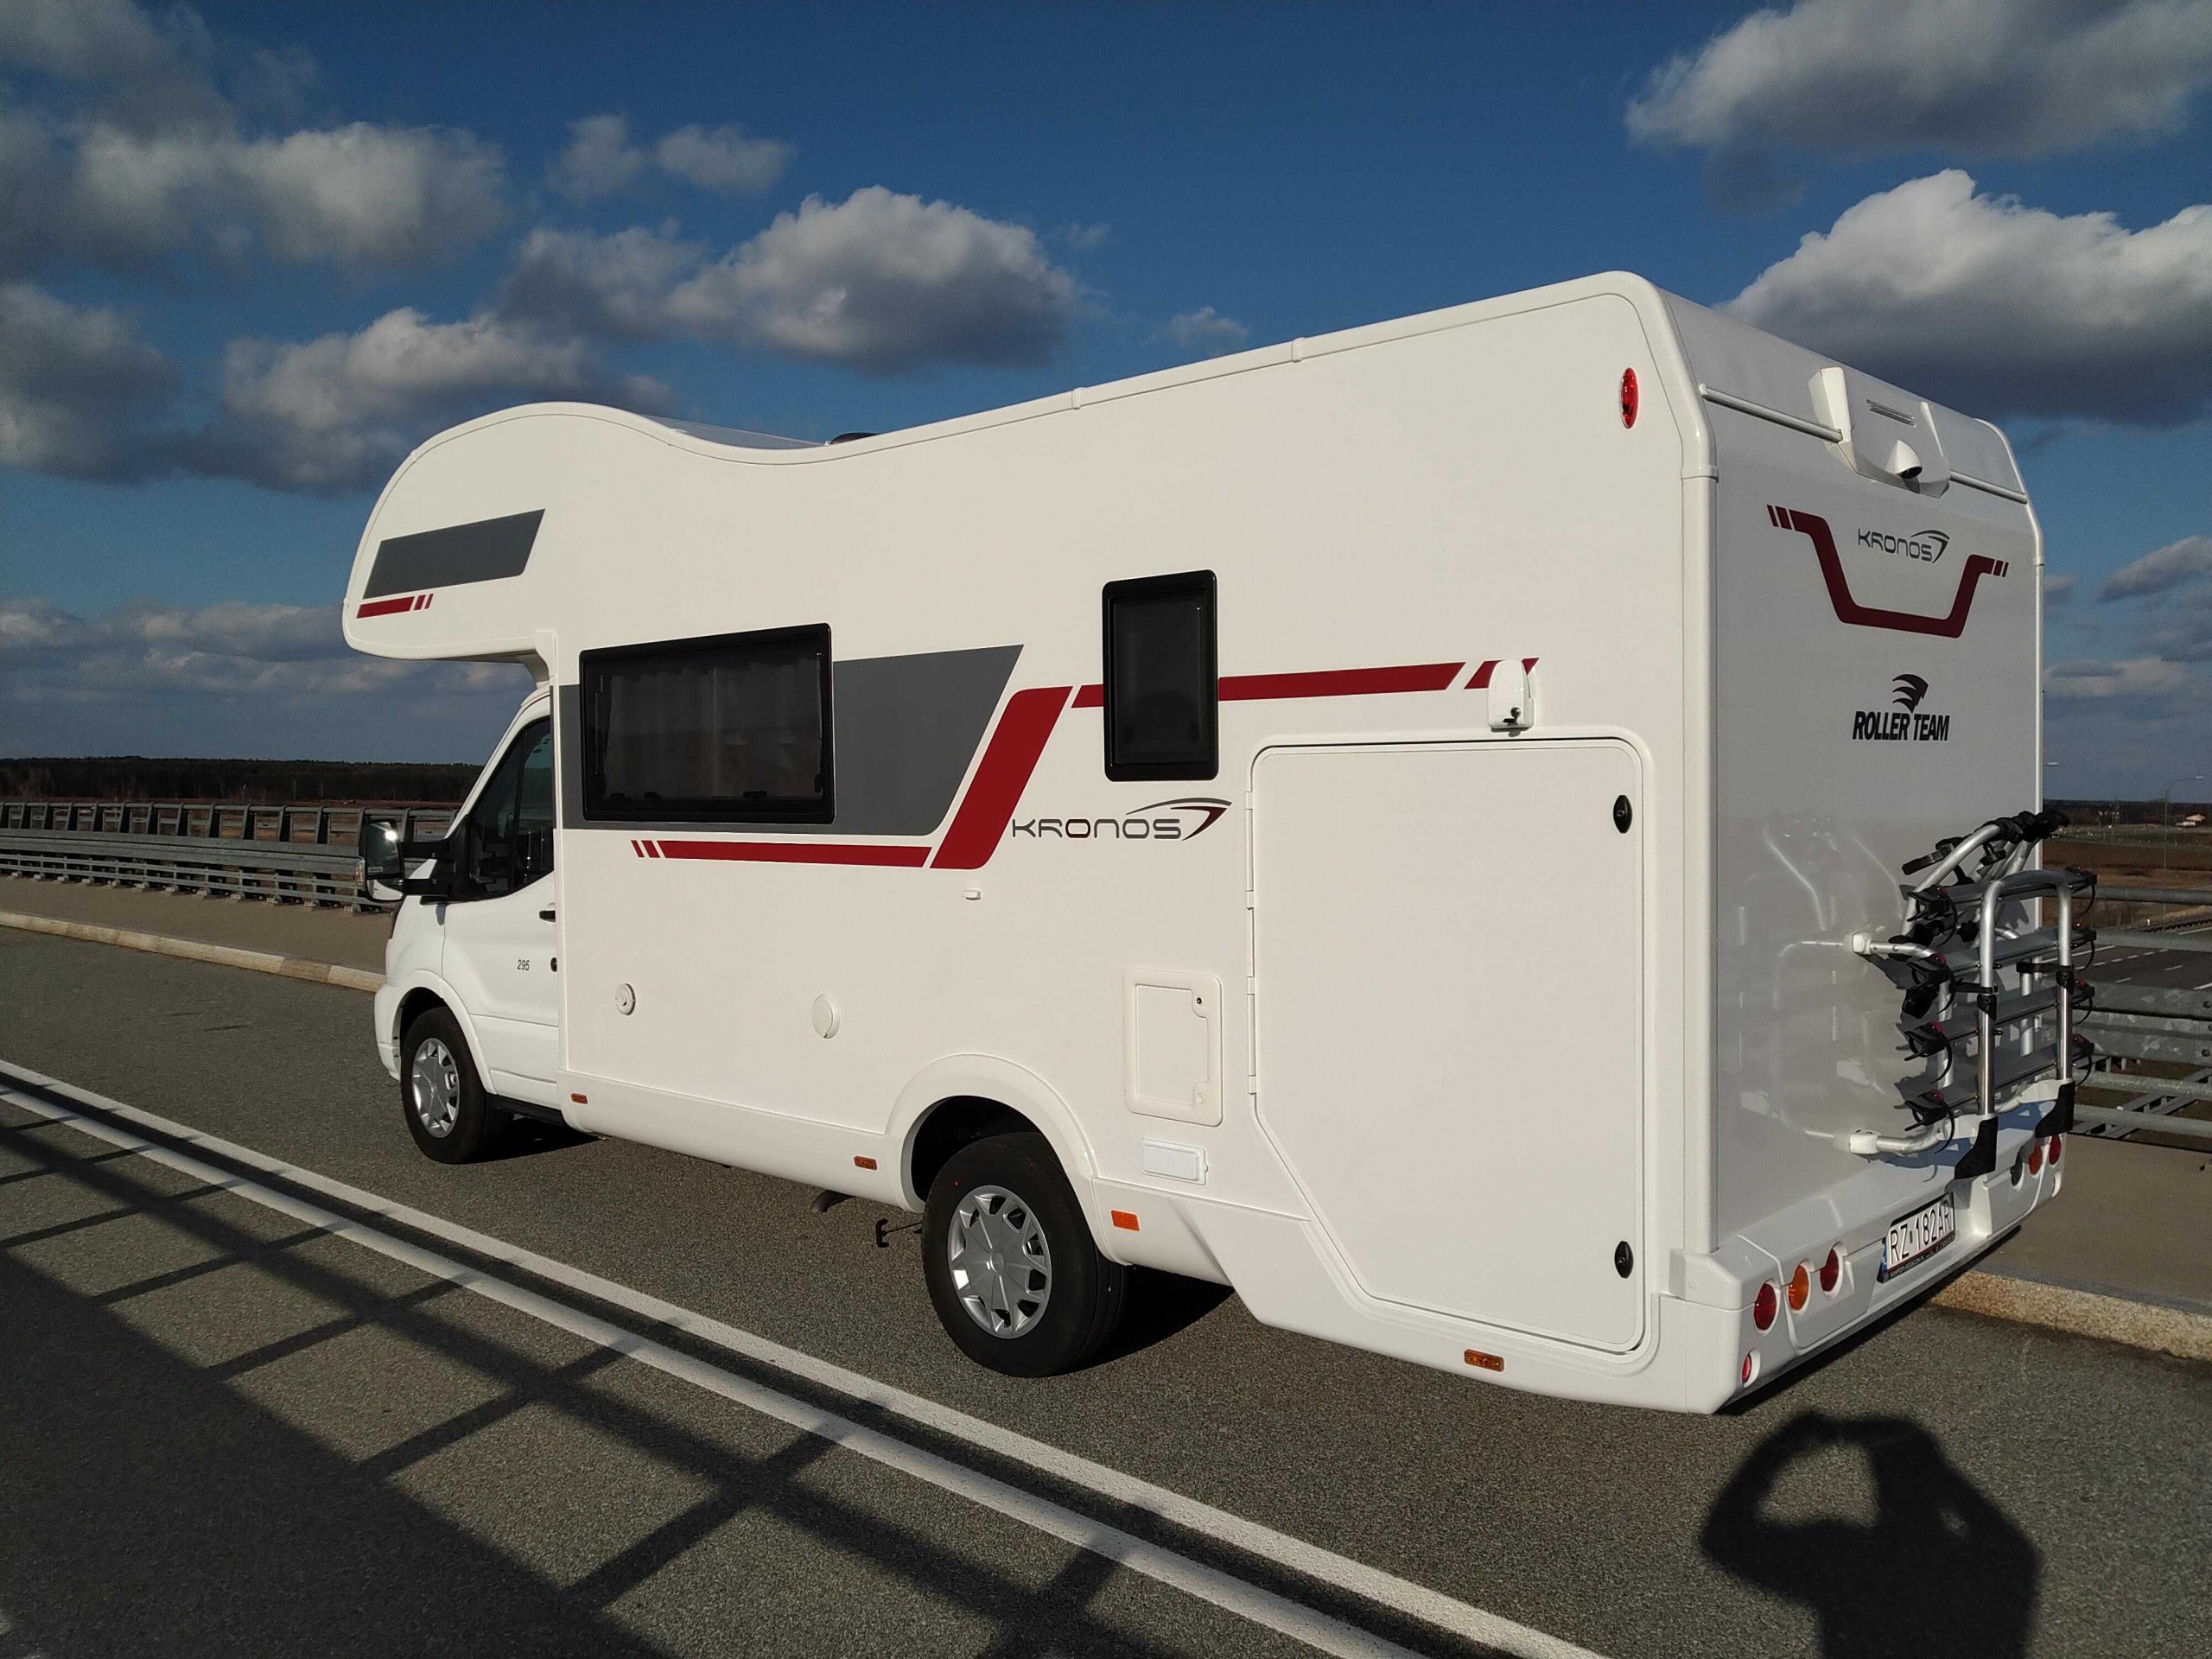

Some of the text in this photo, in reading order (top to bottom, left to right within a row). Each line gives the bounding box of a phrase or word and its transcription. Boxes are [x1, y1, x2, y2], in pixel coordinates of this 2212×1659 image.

[1858, 528, 1933, 562] KRONOS
[1852, 710, 1950, 741] ROLLER TEAM
[1012, 818, 1182, 840] KRONOS
[517, 958, 530, 971] 295
